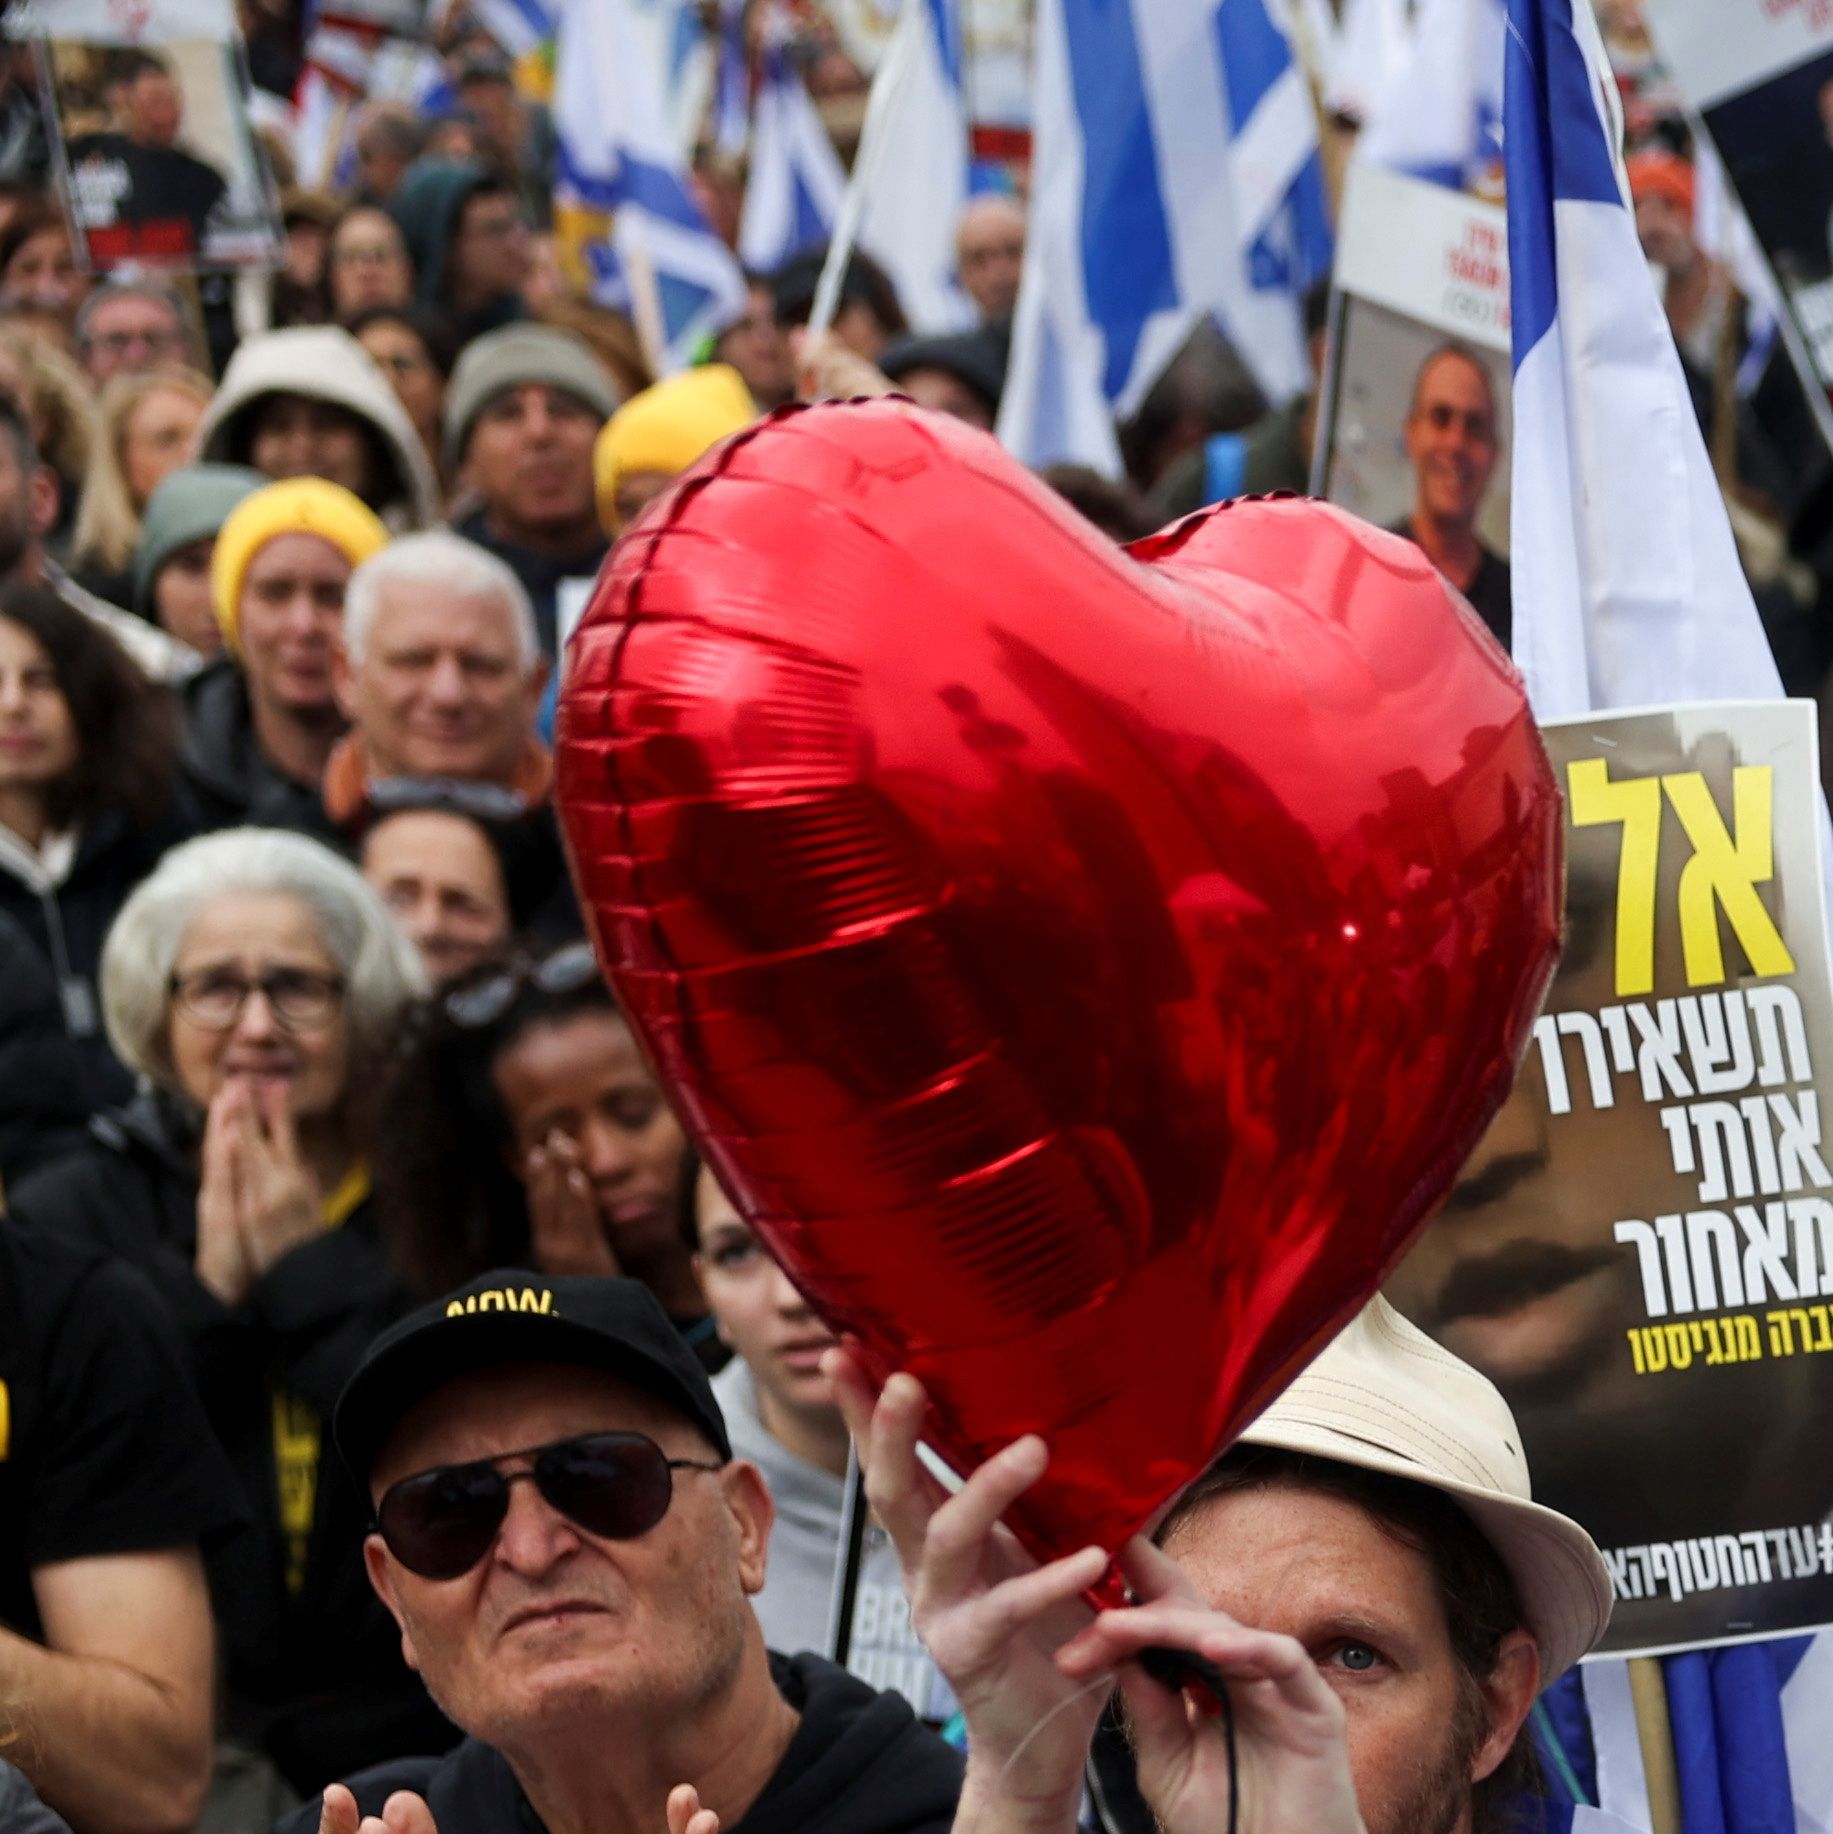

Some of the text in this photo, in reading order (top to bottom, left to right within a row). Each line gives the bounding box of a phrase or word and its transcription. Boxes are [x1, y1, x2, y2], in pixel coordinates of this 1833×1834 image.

[1567, 757, 1797, 997] אל
[1533, 984, 1813, 1115] תשאירו
[1627, 1314, 1763, 1375] מנגיסטו
